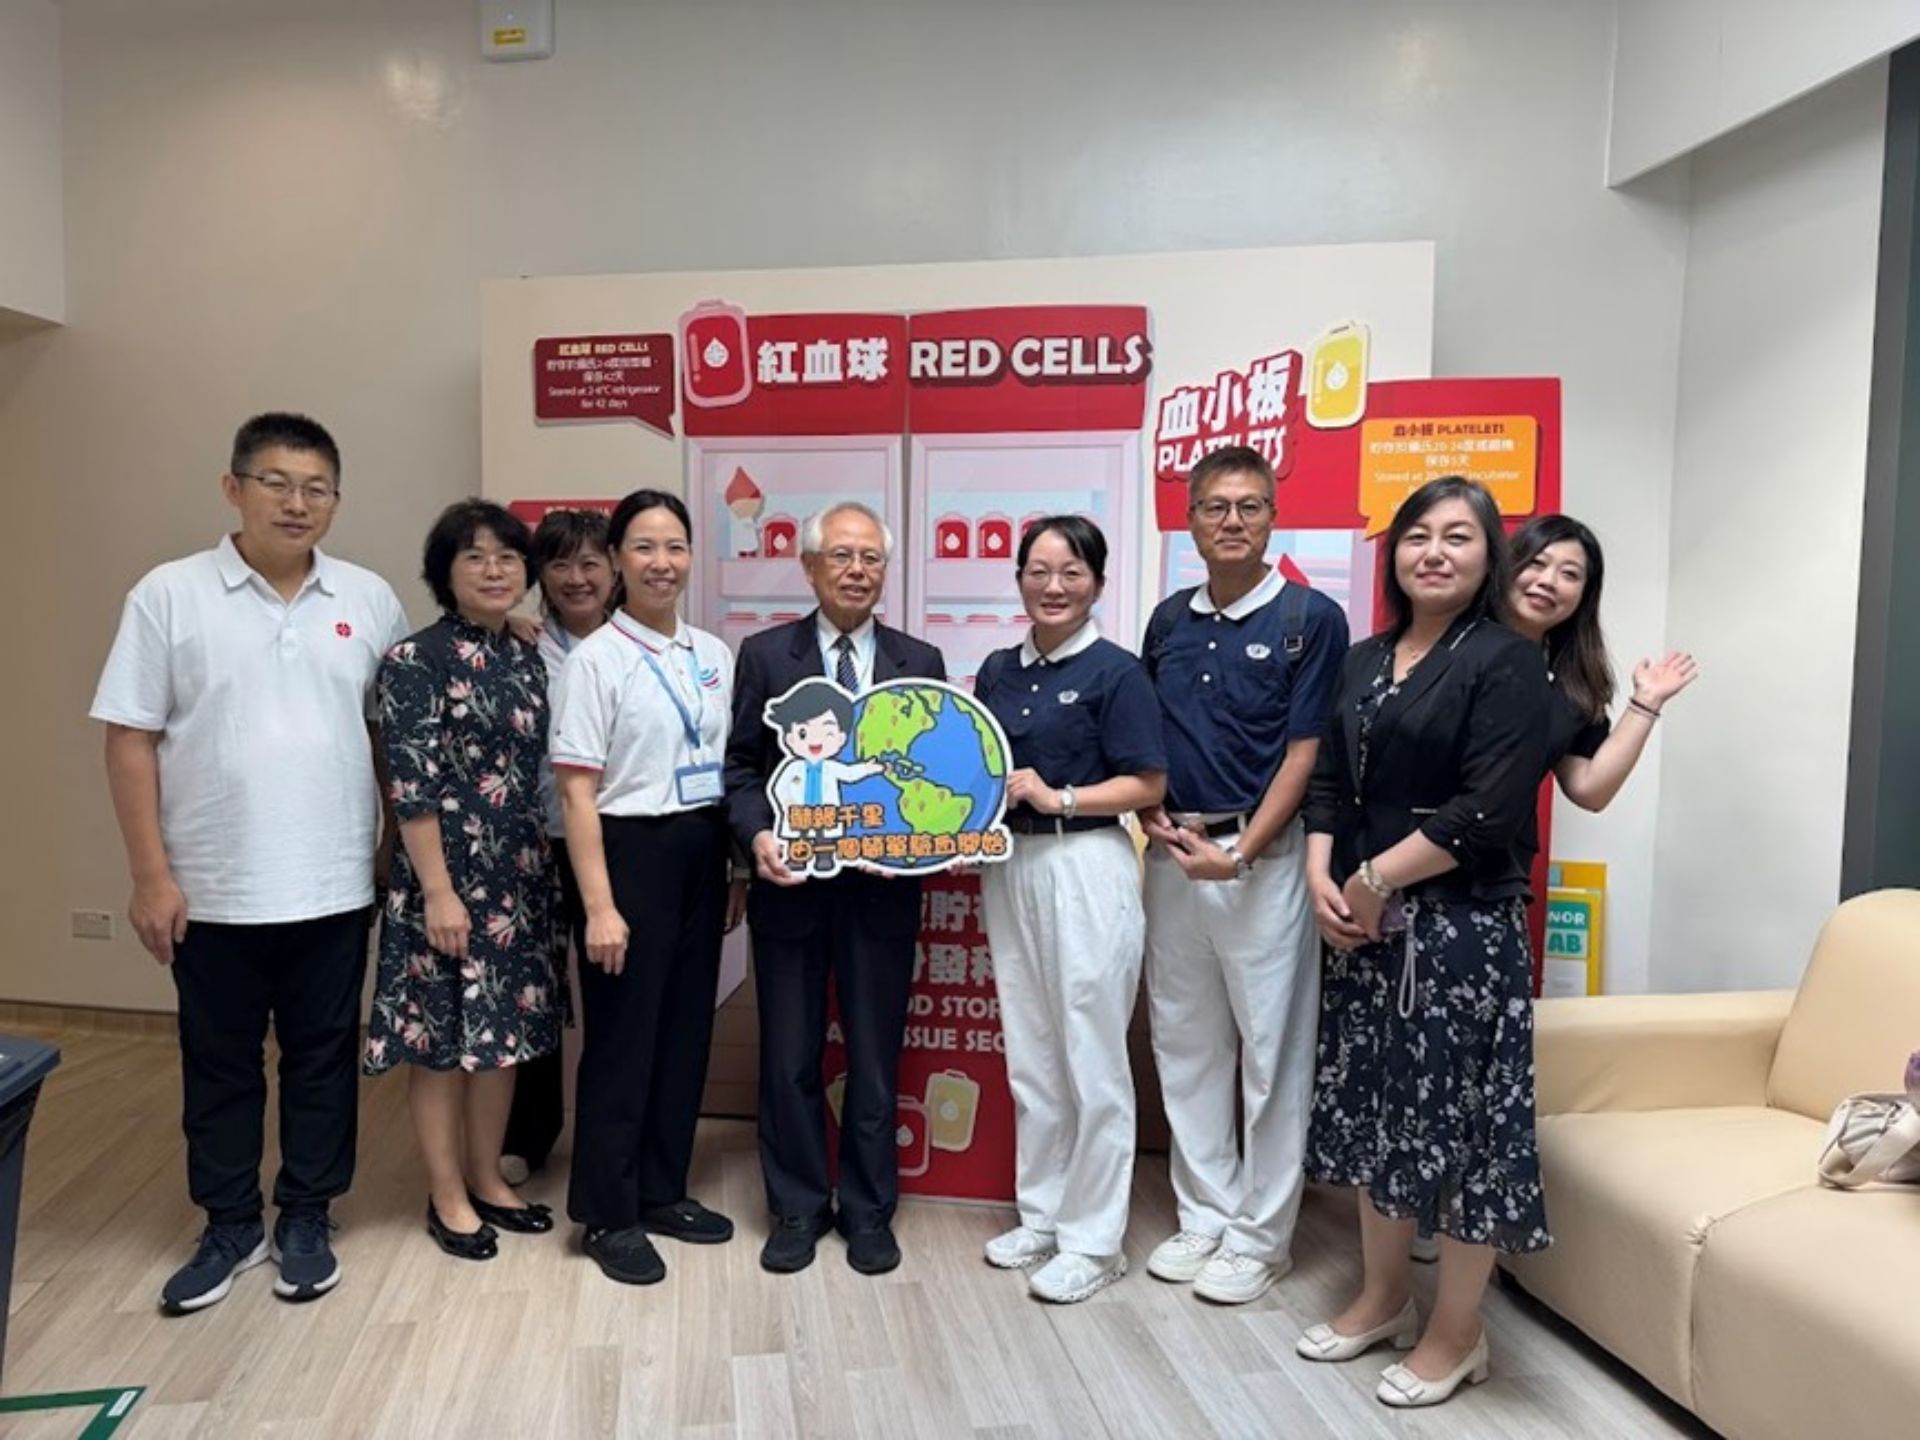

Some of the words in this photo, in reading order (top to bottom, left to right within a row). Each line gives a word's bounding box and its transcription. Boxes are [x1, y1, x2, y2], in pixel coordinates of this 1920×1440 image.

[757, 336, 887, 383] 紅血球
[910, 340, 1001, 378] RED
[1011, 335, 1146, 376] CELLS
[1158, 353, 1292, 440] 血小板
[1437, 423, 1505, 435] PLATELETS
